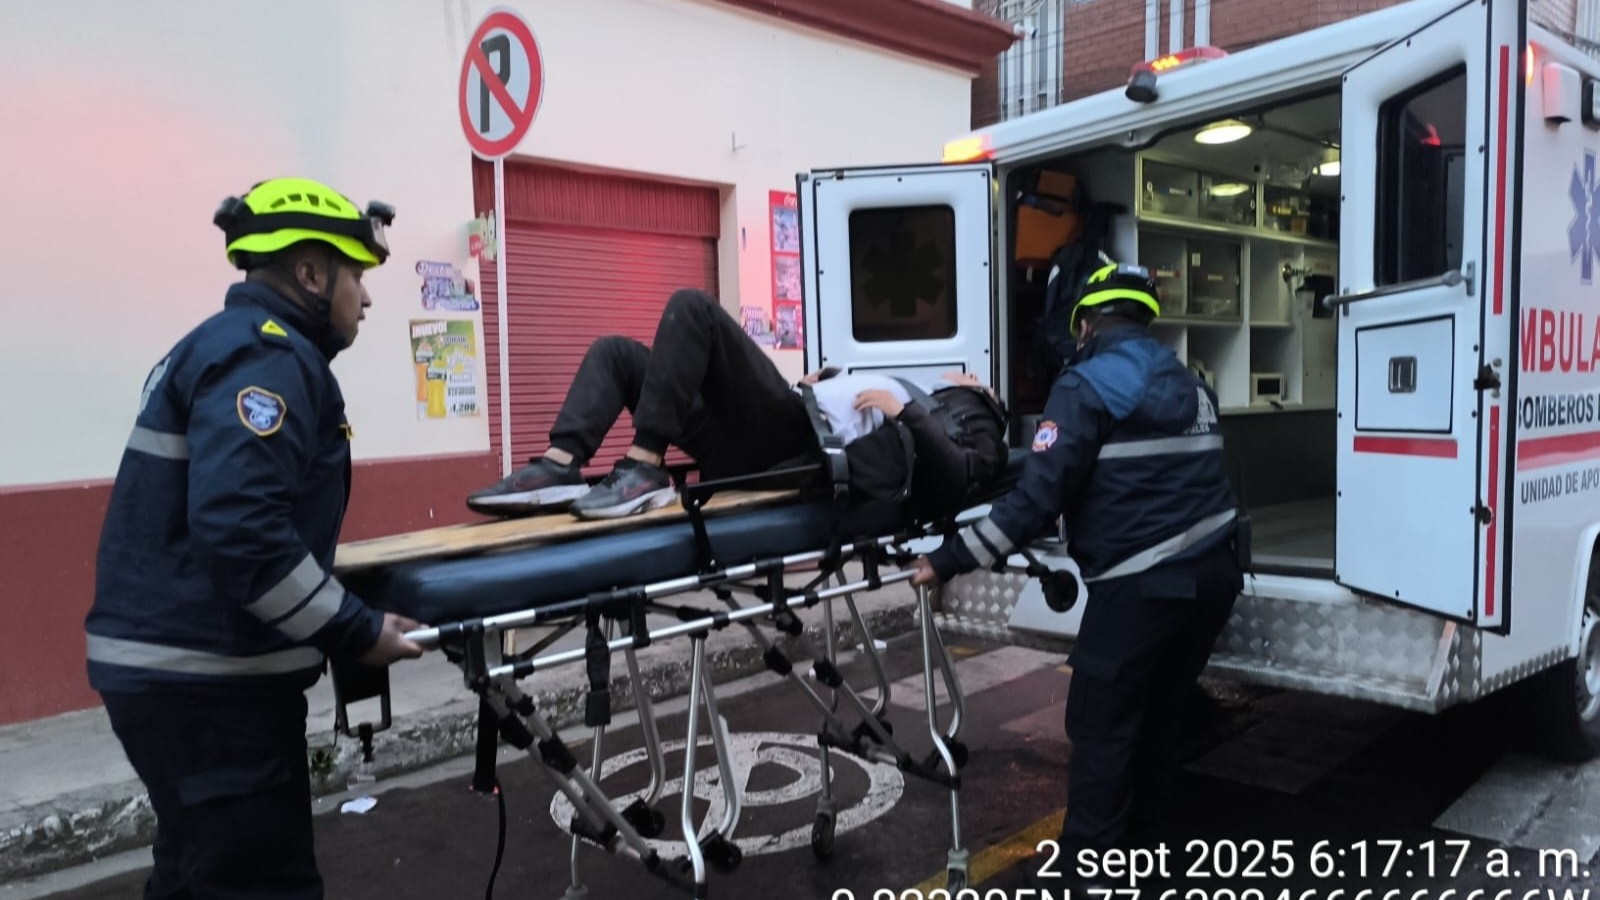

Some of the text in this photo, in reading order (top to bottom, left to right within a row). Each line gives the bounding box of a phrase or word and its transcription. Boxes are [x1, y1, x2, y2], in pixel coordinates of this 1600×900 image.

[480, 33, 511, 134] P
[1519, 394, 1594, 430] OMBEROS
[1521, 476, 1562, 504] UNIDAD
[1565, 472, 1579, 495] DE
